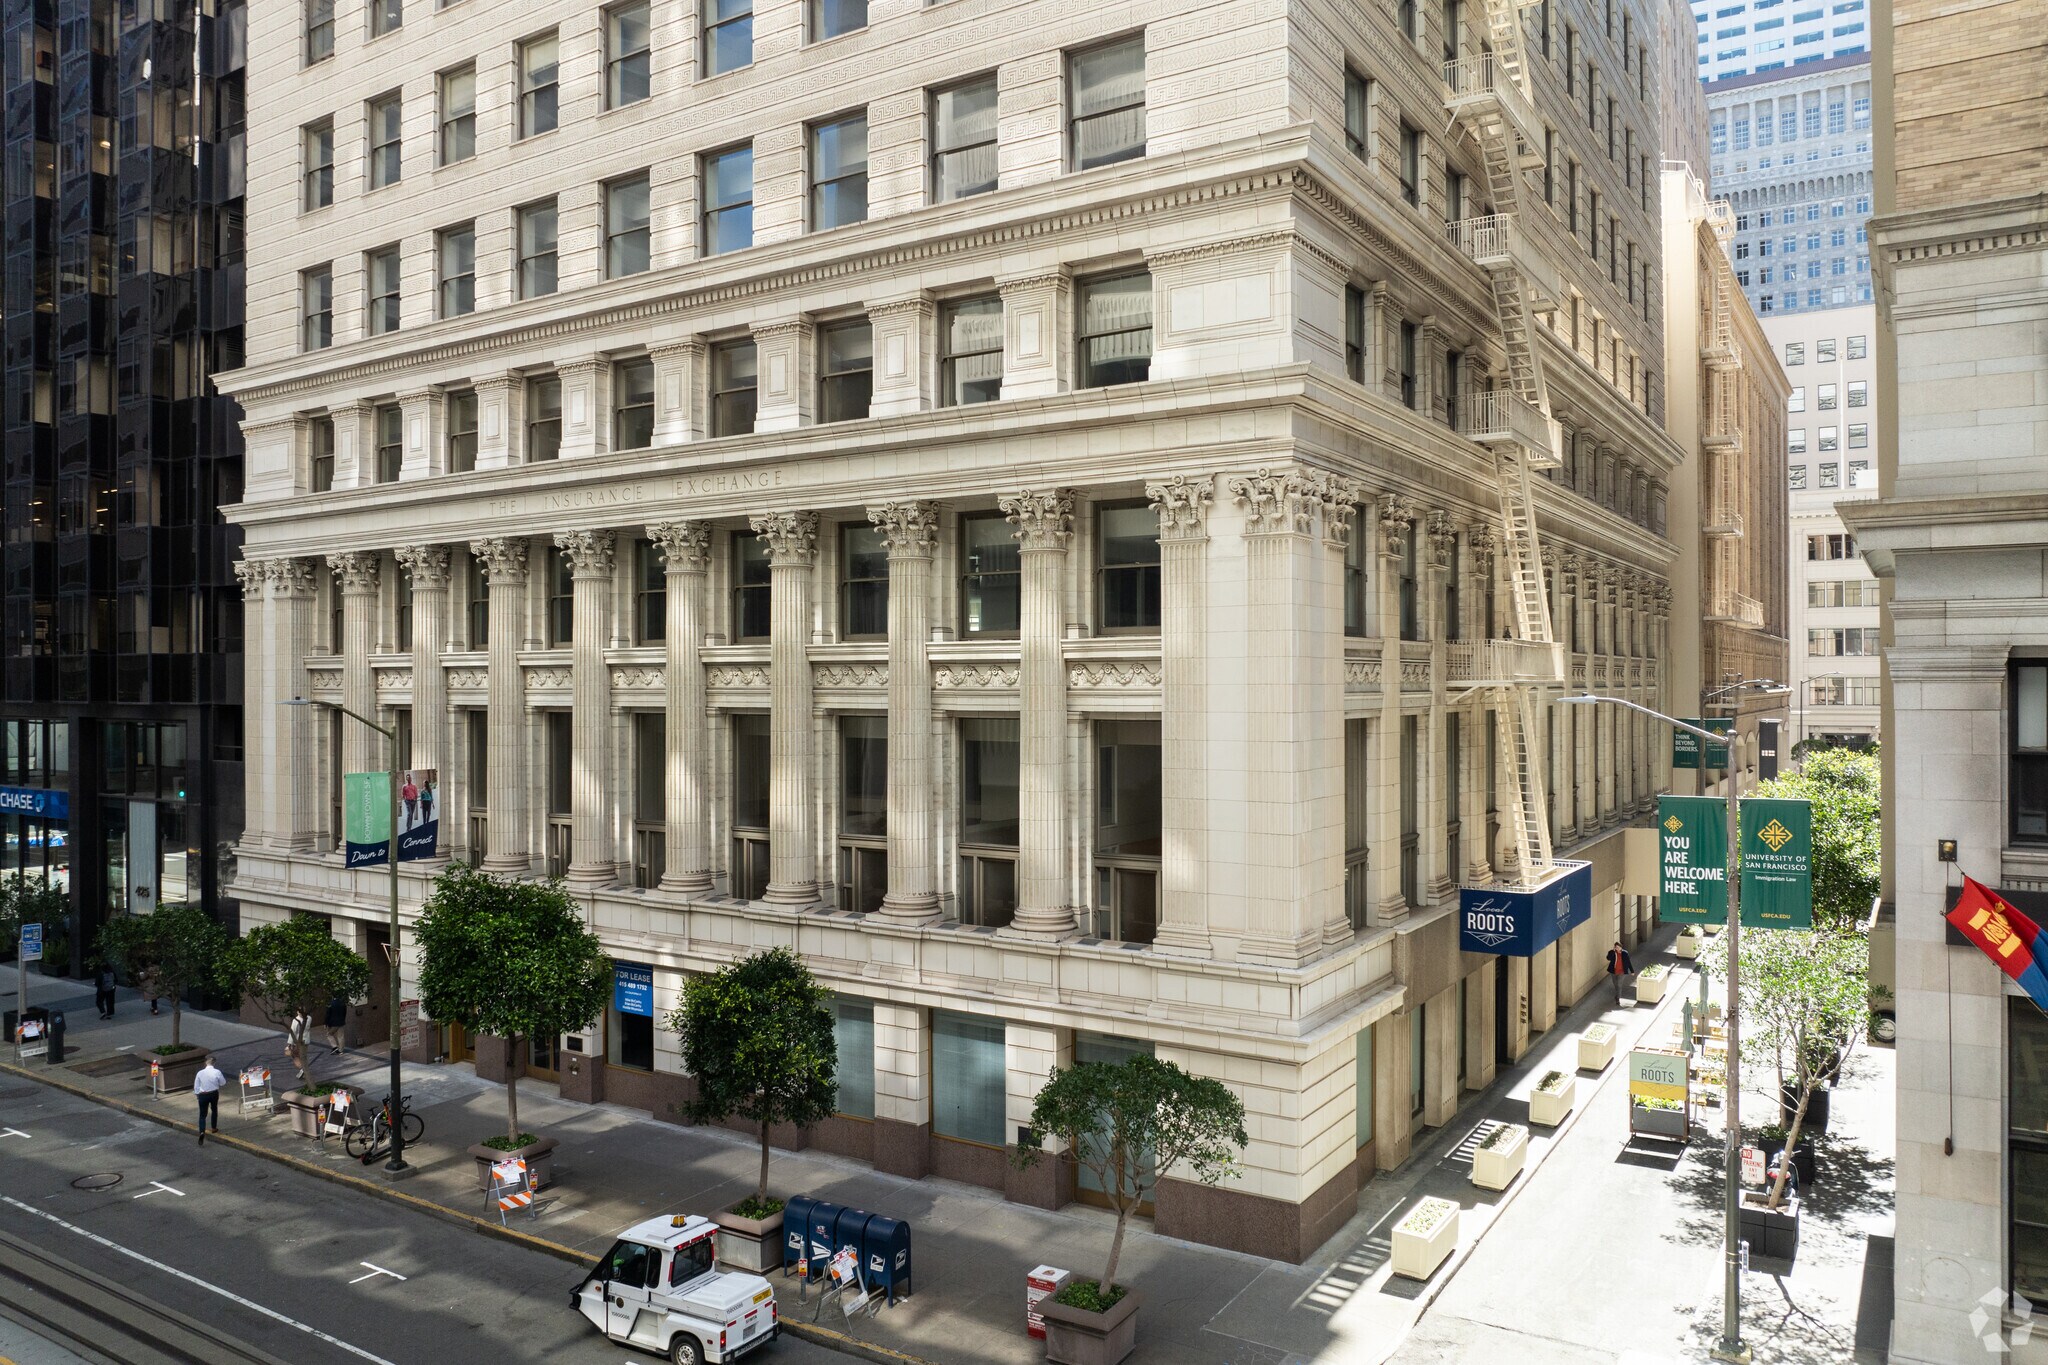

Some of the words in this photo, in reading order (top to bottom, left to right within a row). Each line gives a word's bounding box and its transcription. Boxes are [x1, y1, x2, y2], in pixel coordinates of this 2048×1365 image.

[490, 500, 516, 515] THE
[544, 486, 643, 510] INSURANCE
[676, 470, 782, 495] EXCHANGE
[0, 793, 33, 810] CHASE
[403, 835, 433, 849] Connect
[1664, 836, 1690, 849] YOU
[351, 851, 376, 863] Down
[378, 848, 386, 856] to
[1664, 852, 1688, 864] ARE
[1745, 854, 1792, 862] UNIVERSITY
[1664, 866, 1724, 881] WELCOME
[1762, 863, 1807, 871] FRANCISCO
[1664, 881, 1699, 895] HERE.
[1471, 898, 1512, 913] Local
[1467, 912, 1514, 933] ROOTS
[630, 973, 650, 982] LEASE
[1644, 1060, 1672, 1070] Local
[1641, 1069, 1674, 1083] ROOTS
[1742, 1150, 1752, 1158] NO
[1744, 1160, 1763, 1168] PARKING
